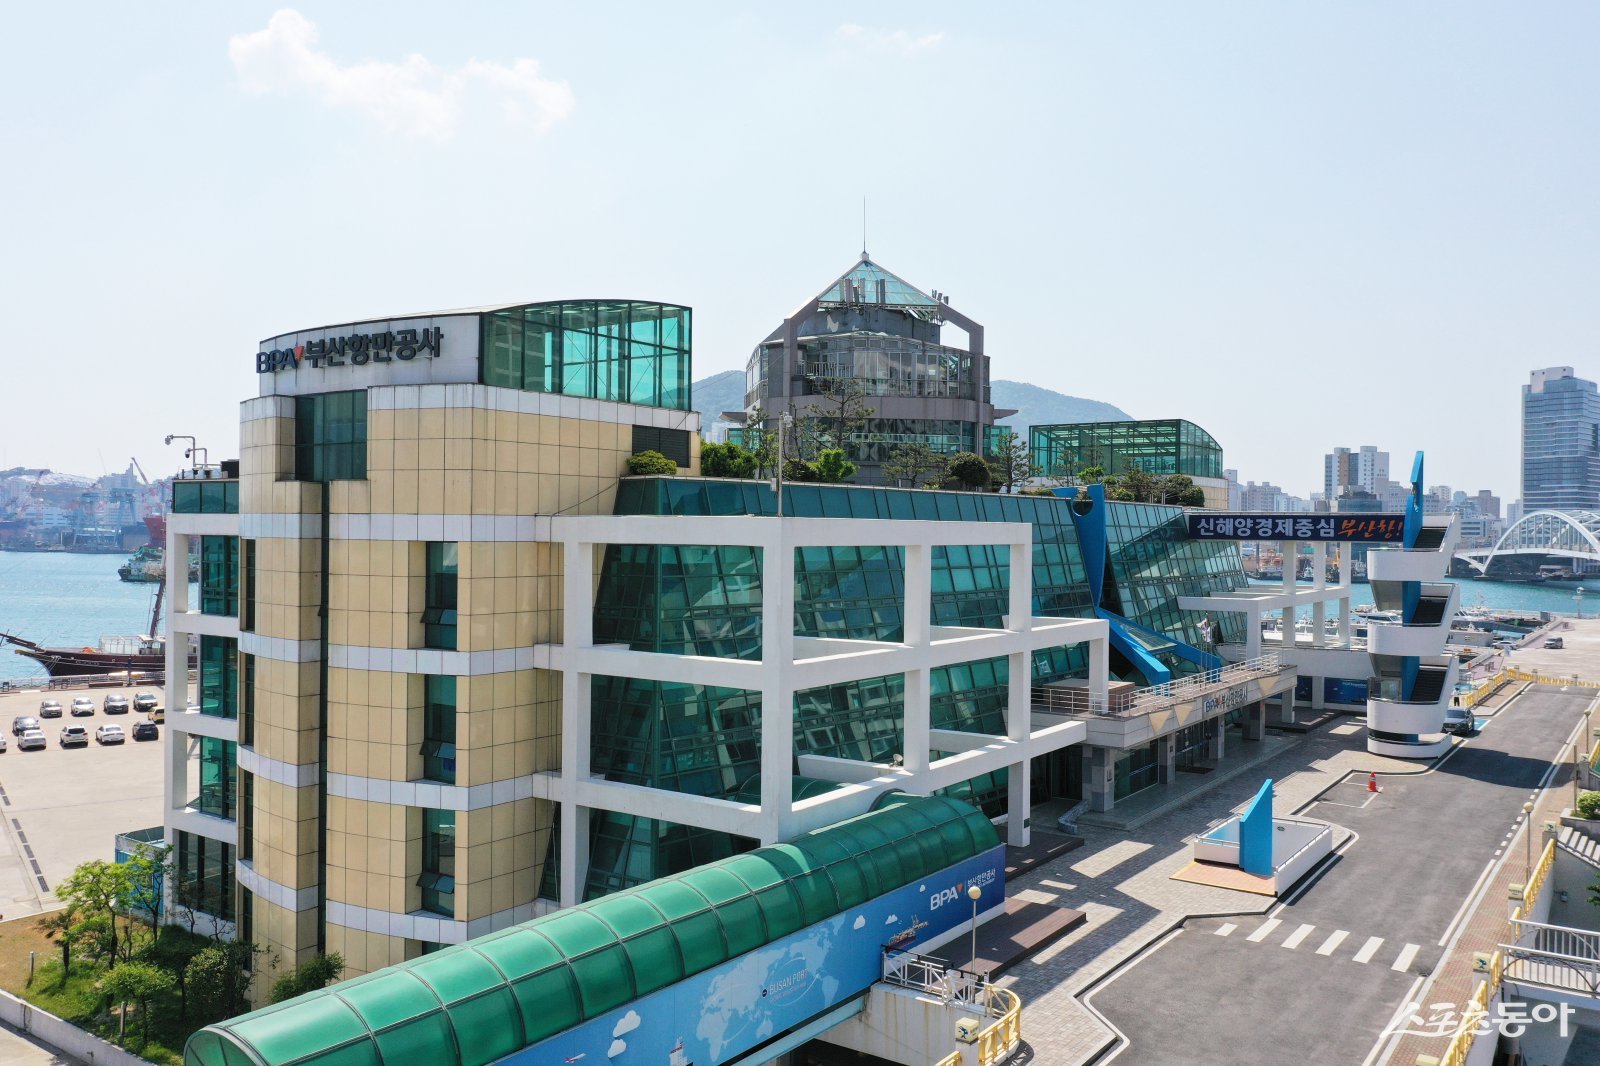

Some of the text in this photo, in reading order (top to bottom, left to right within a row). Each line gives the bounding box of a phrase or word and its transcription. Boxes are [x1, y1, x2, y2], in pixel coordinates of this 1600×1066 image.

[256, 327, 444, 373] BPA 부산항만공사
[1197, 518, 1335, 537] 신해양경제중심
[930, 886, 959, 911] BPA
